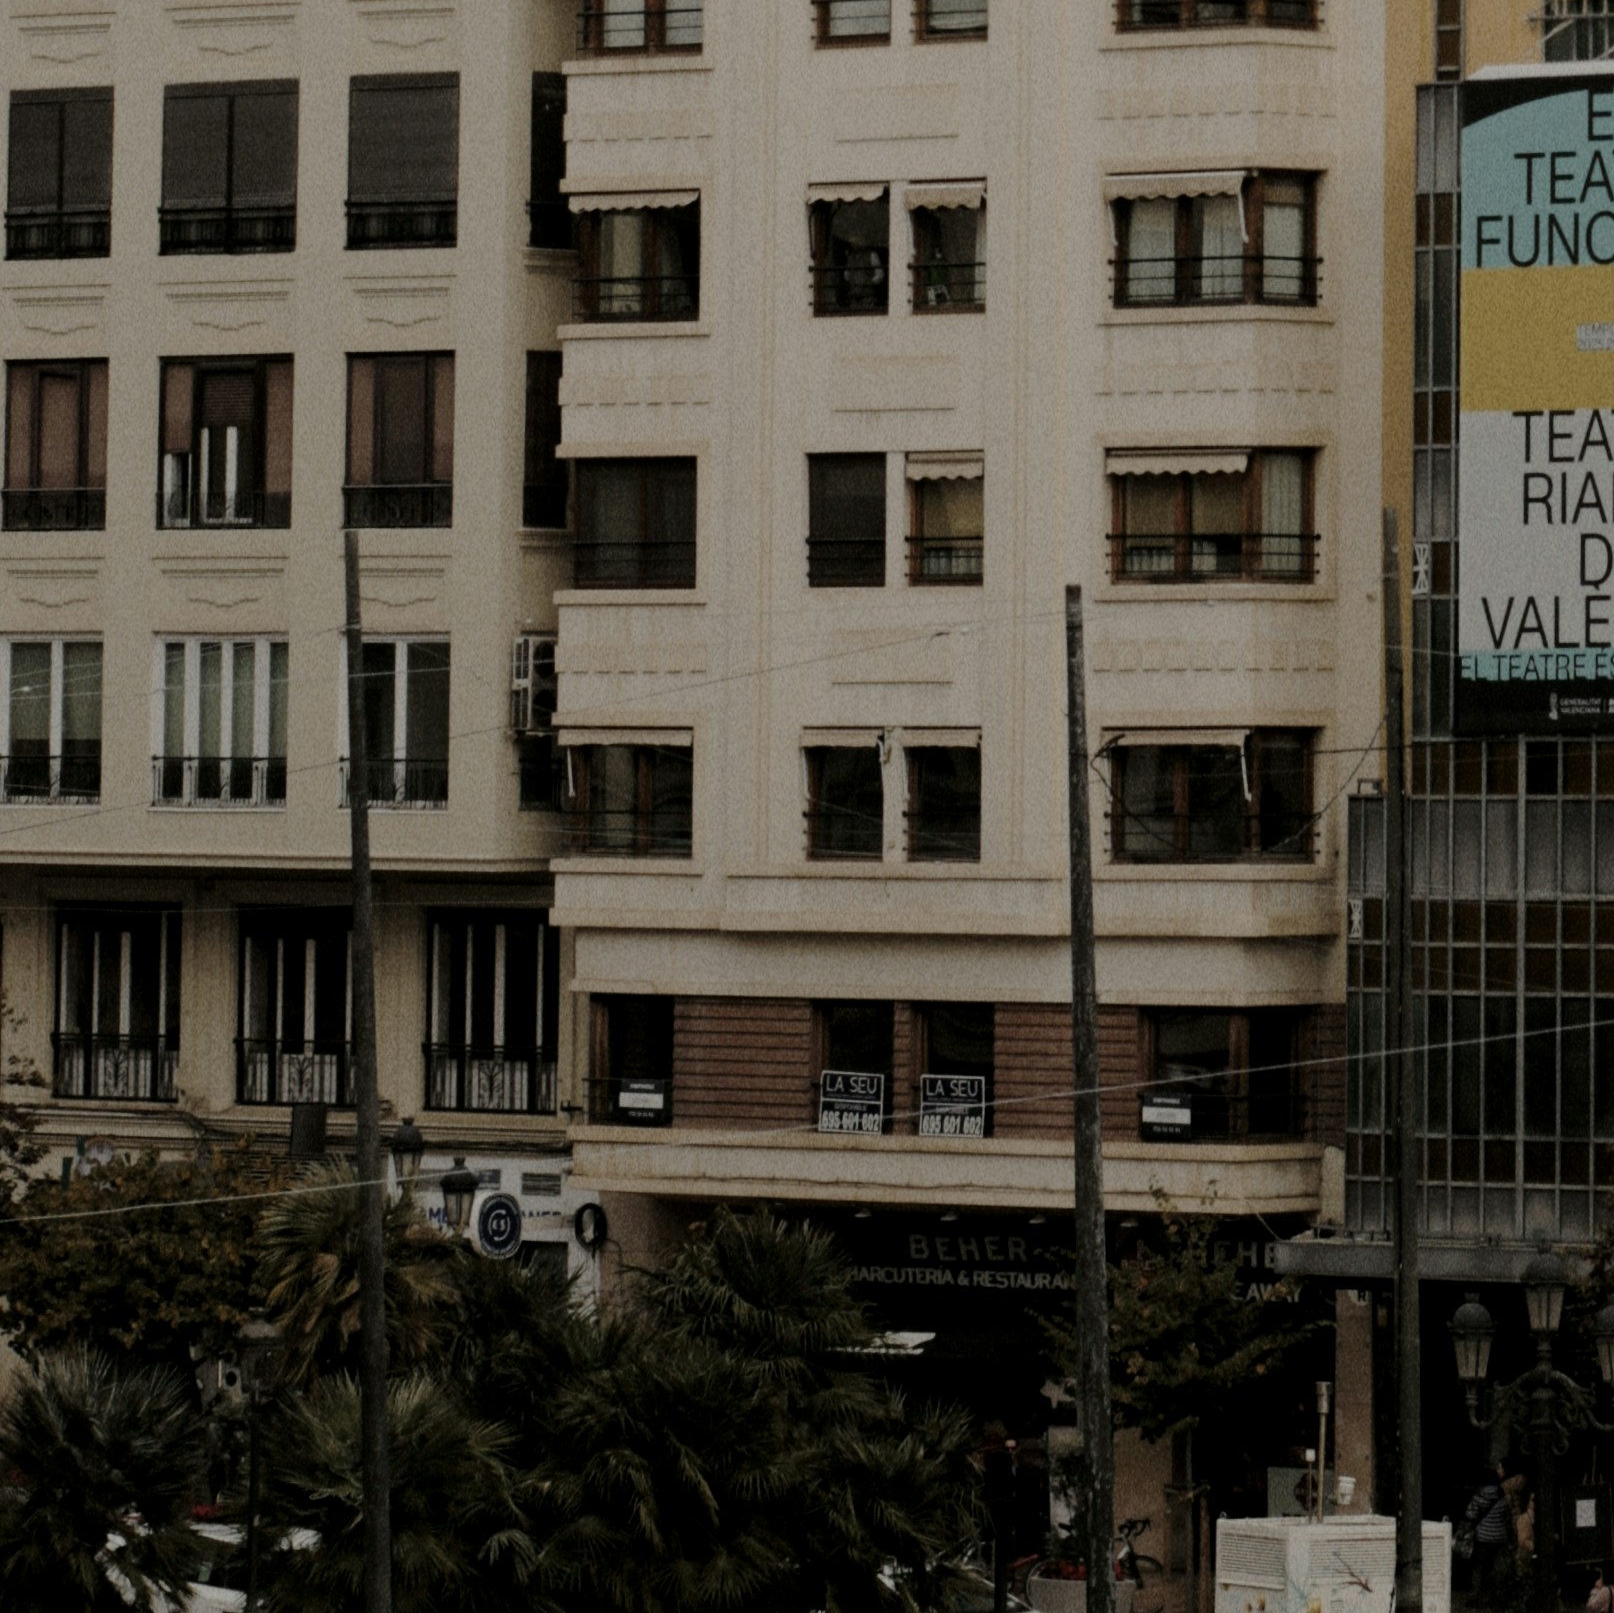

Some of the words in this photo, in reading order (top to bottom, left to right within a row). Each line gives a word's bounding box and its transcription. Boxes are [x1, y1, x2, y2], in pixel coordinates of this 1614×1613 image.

[1492, 654, 1585, 681] TEATRE
[826, 1075, 844, 1092] LA
[850, 1077, 878, 1094] SEU
[925, 1079, 945, 1096] LA
[950, 1080, 979, 1097] SEU
[822, 1110, 841, 1129] 695
[842, 1111, 859, 1131] 601
[922, 1114, 941, 1134] 695
[943, 1115, 961, 1135] 601
[909, 1233, 1028, 1262] BEHER
[849, 1264, 955, 1287] HARCUTERÍA
[957, 1269, 971, 1288] &
[972, 1269, 1077, 1291] RESTAURAN
